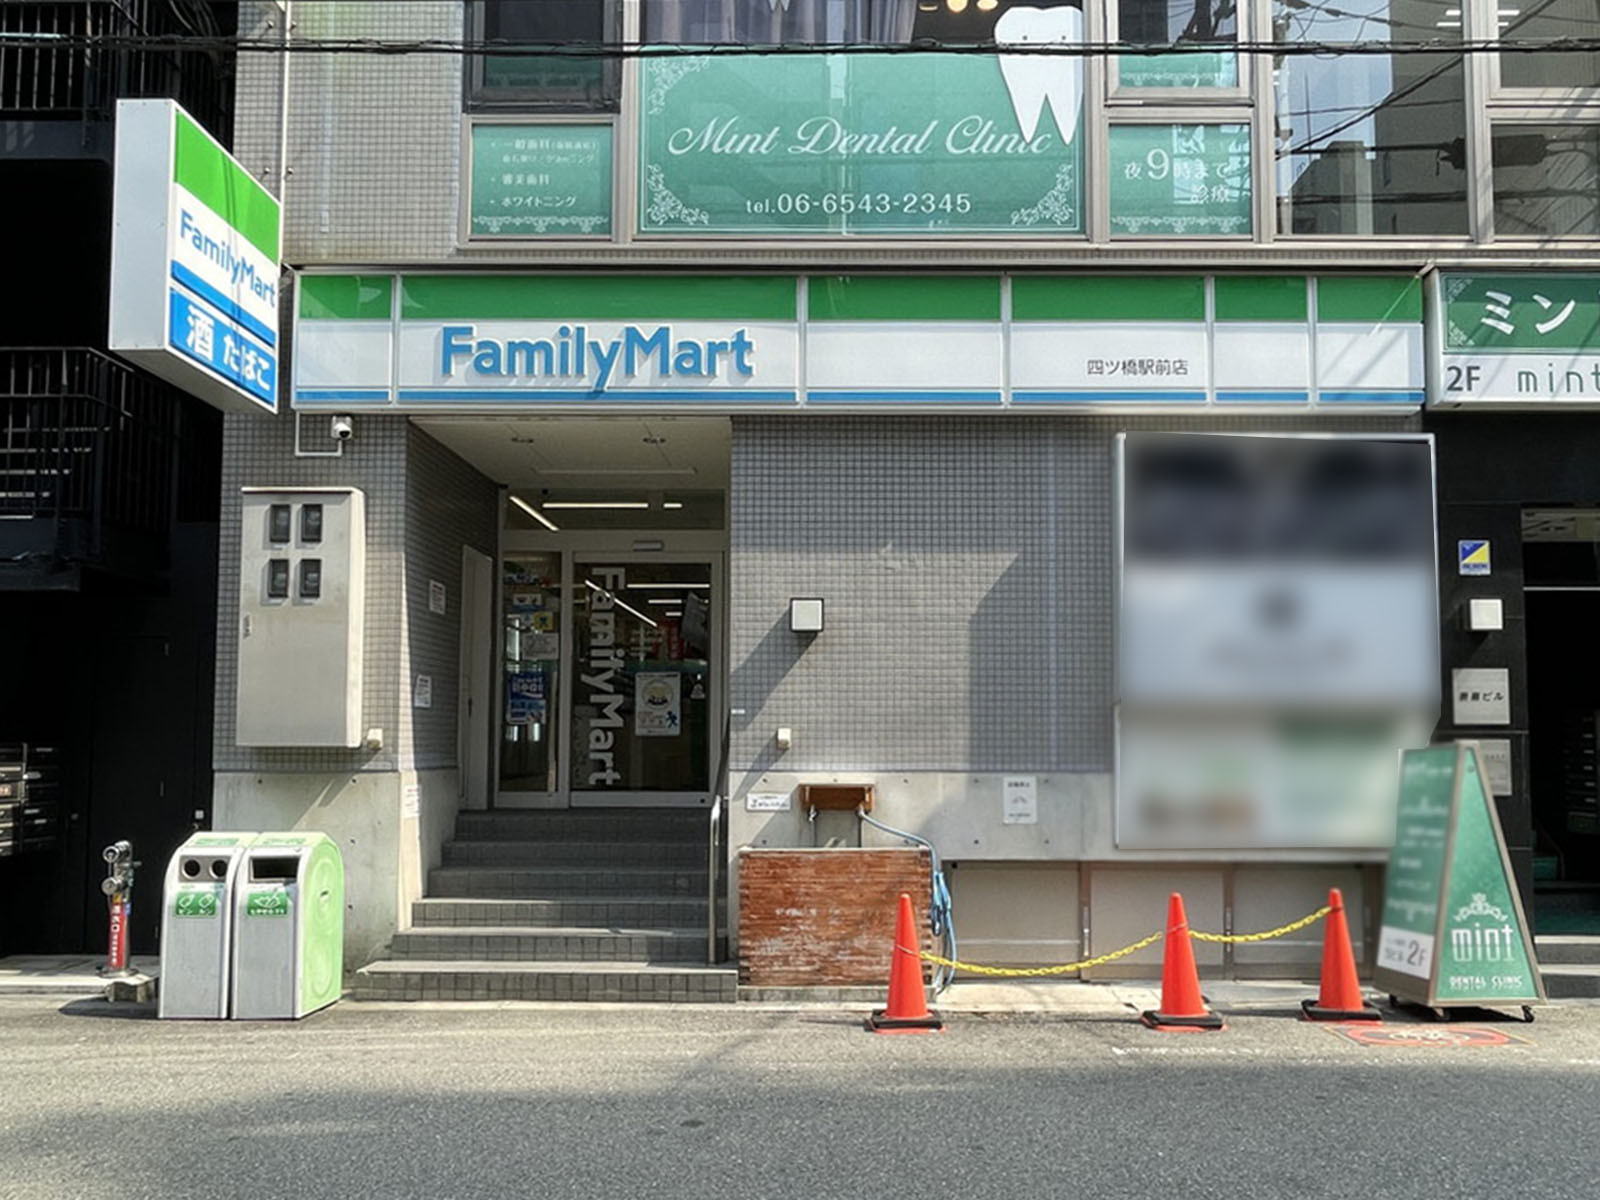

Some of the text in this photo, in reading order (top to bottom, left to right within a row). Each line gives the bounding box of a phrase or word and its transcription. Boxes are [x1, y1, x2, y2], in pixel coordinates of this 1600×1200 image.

[668, 115, 780, 156] Mint
[788, 115, 939, 155] Dental
[180, 208, 276, 308] FamilyMart
[187, 303, 271, 391] 酒 たばこ
[441, 324, 754, 393] FamilyMart
[1087, 359, 1189, 376] 四ツ橋駅前店
[1447, 363, 1600, 393] 2F mint
[580, 567, 627, 786] FamilyMart
[1451, 923, 1514, 962] mint
